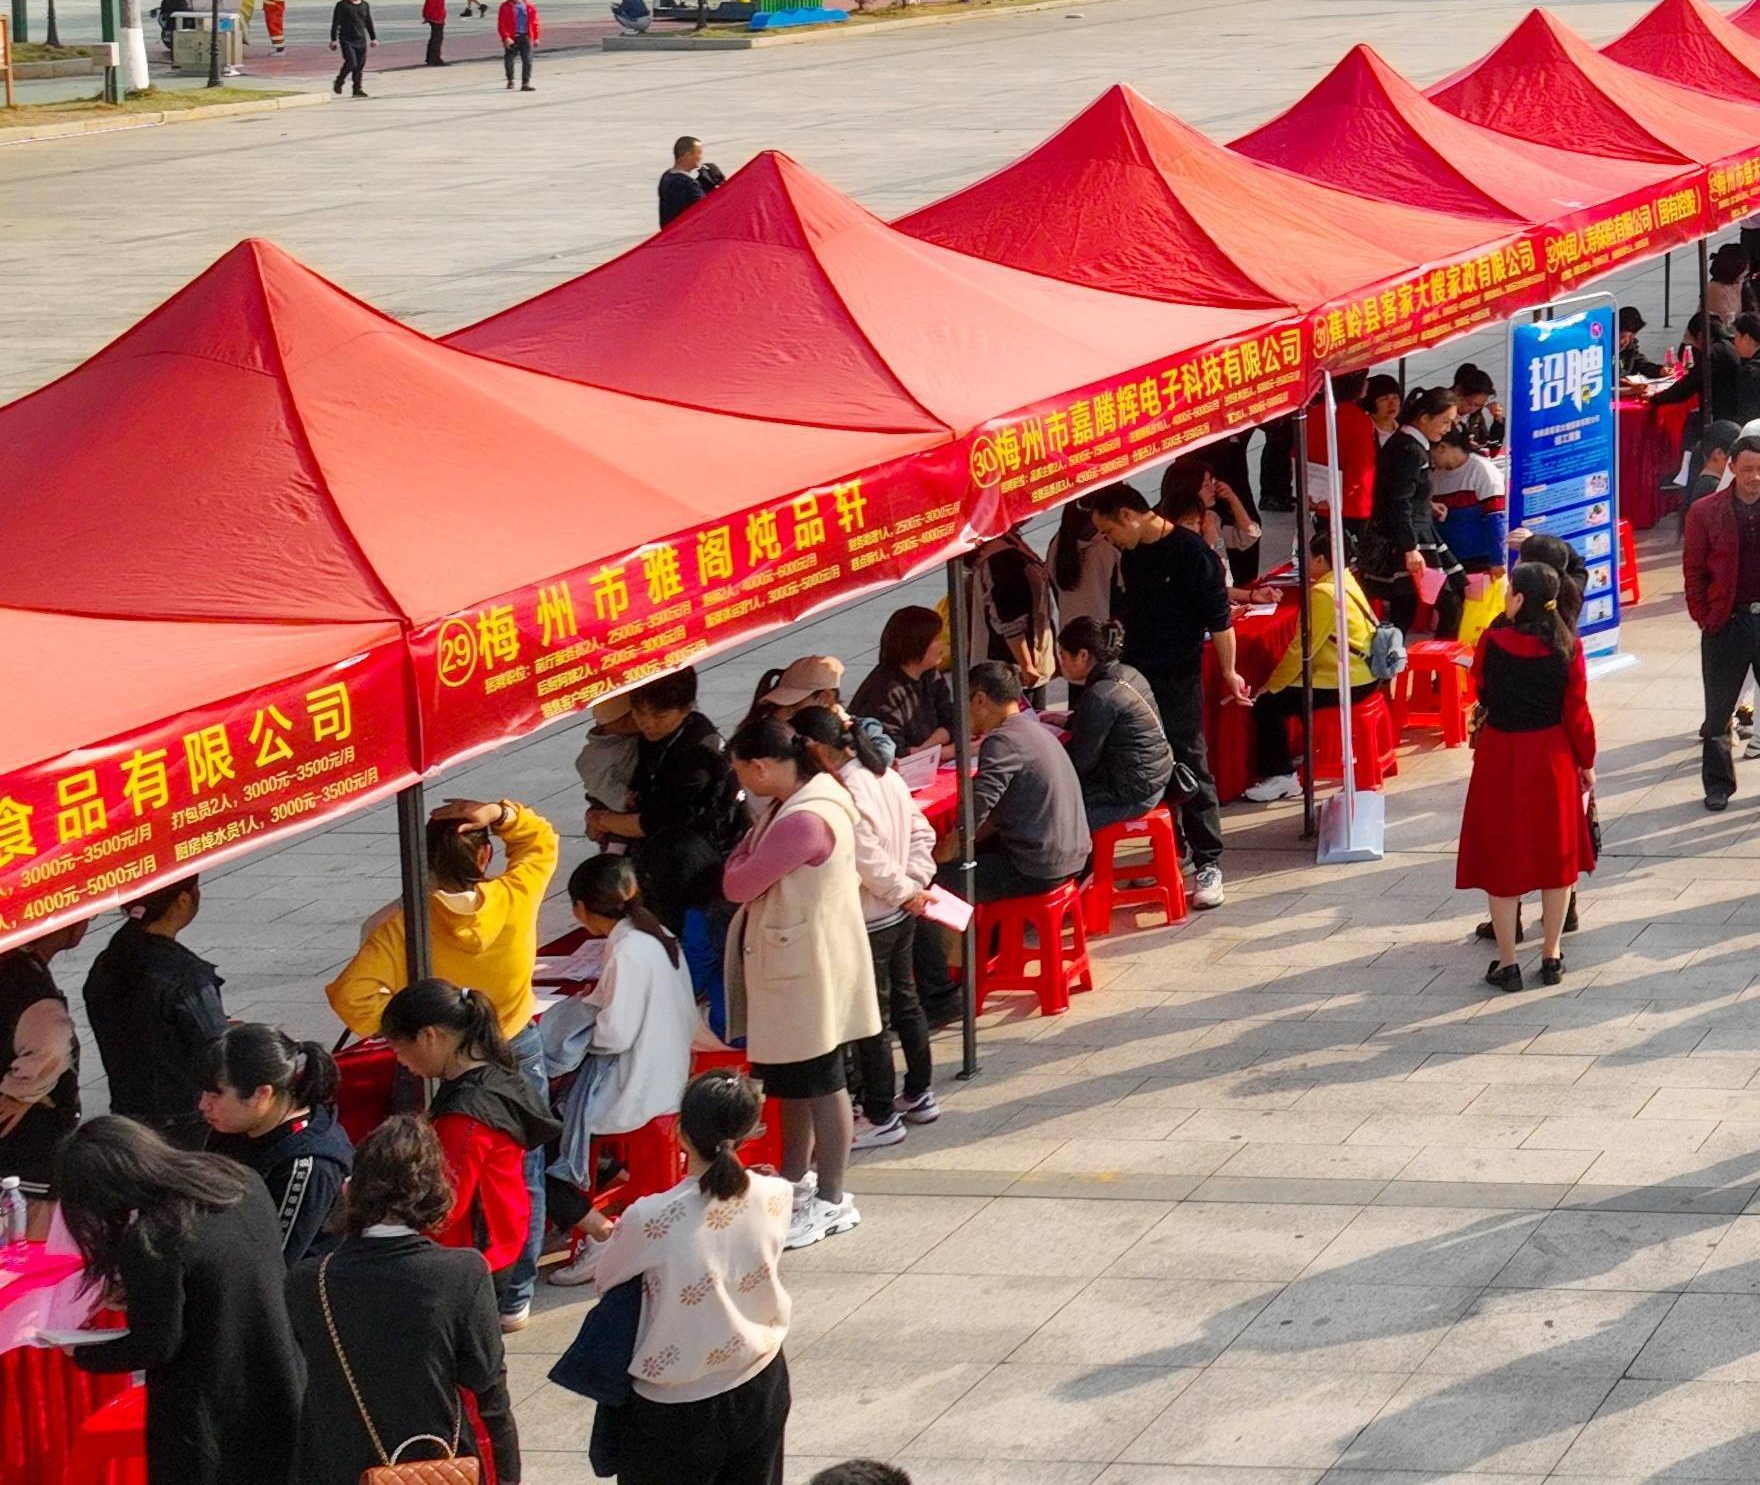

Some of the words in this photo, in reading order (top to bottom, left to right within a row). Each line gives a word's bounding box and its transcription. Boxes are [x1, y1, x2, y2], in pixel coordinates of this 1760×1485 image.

[1327, 239, 1536, 349] 蕉岭县客家大嫂家政有限公司
[995, 328, 1301, 477] 梅州市嘉腾辉电子科技有限公司
[1529, 345, 1604, 412] 招聘
[477, 479, 867, 670] 梅州市雅阁炖品轩
